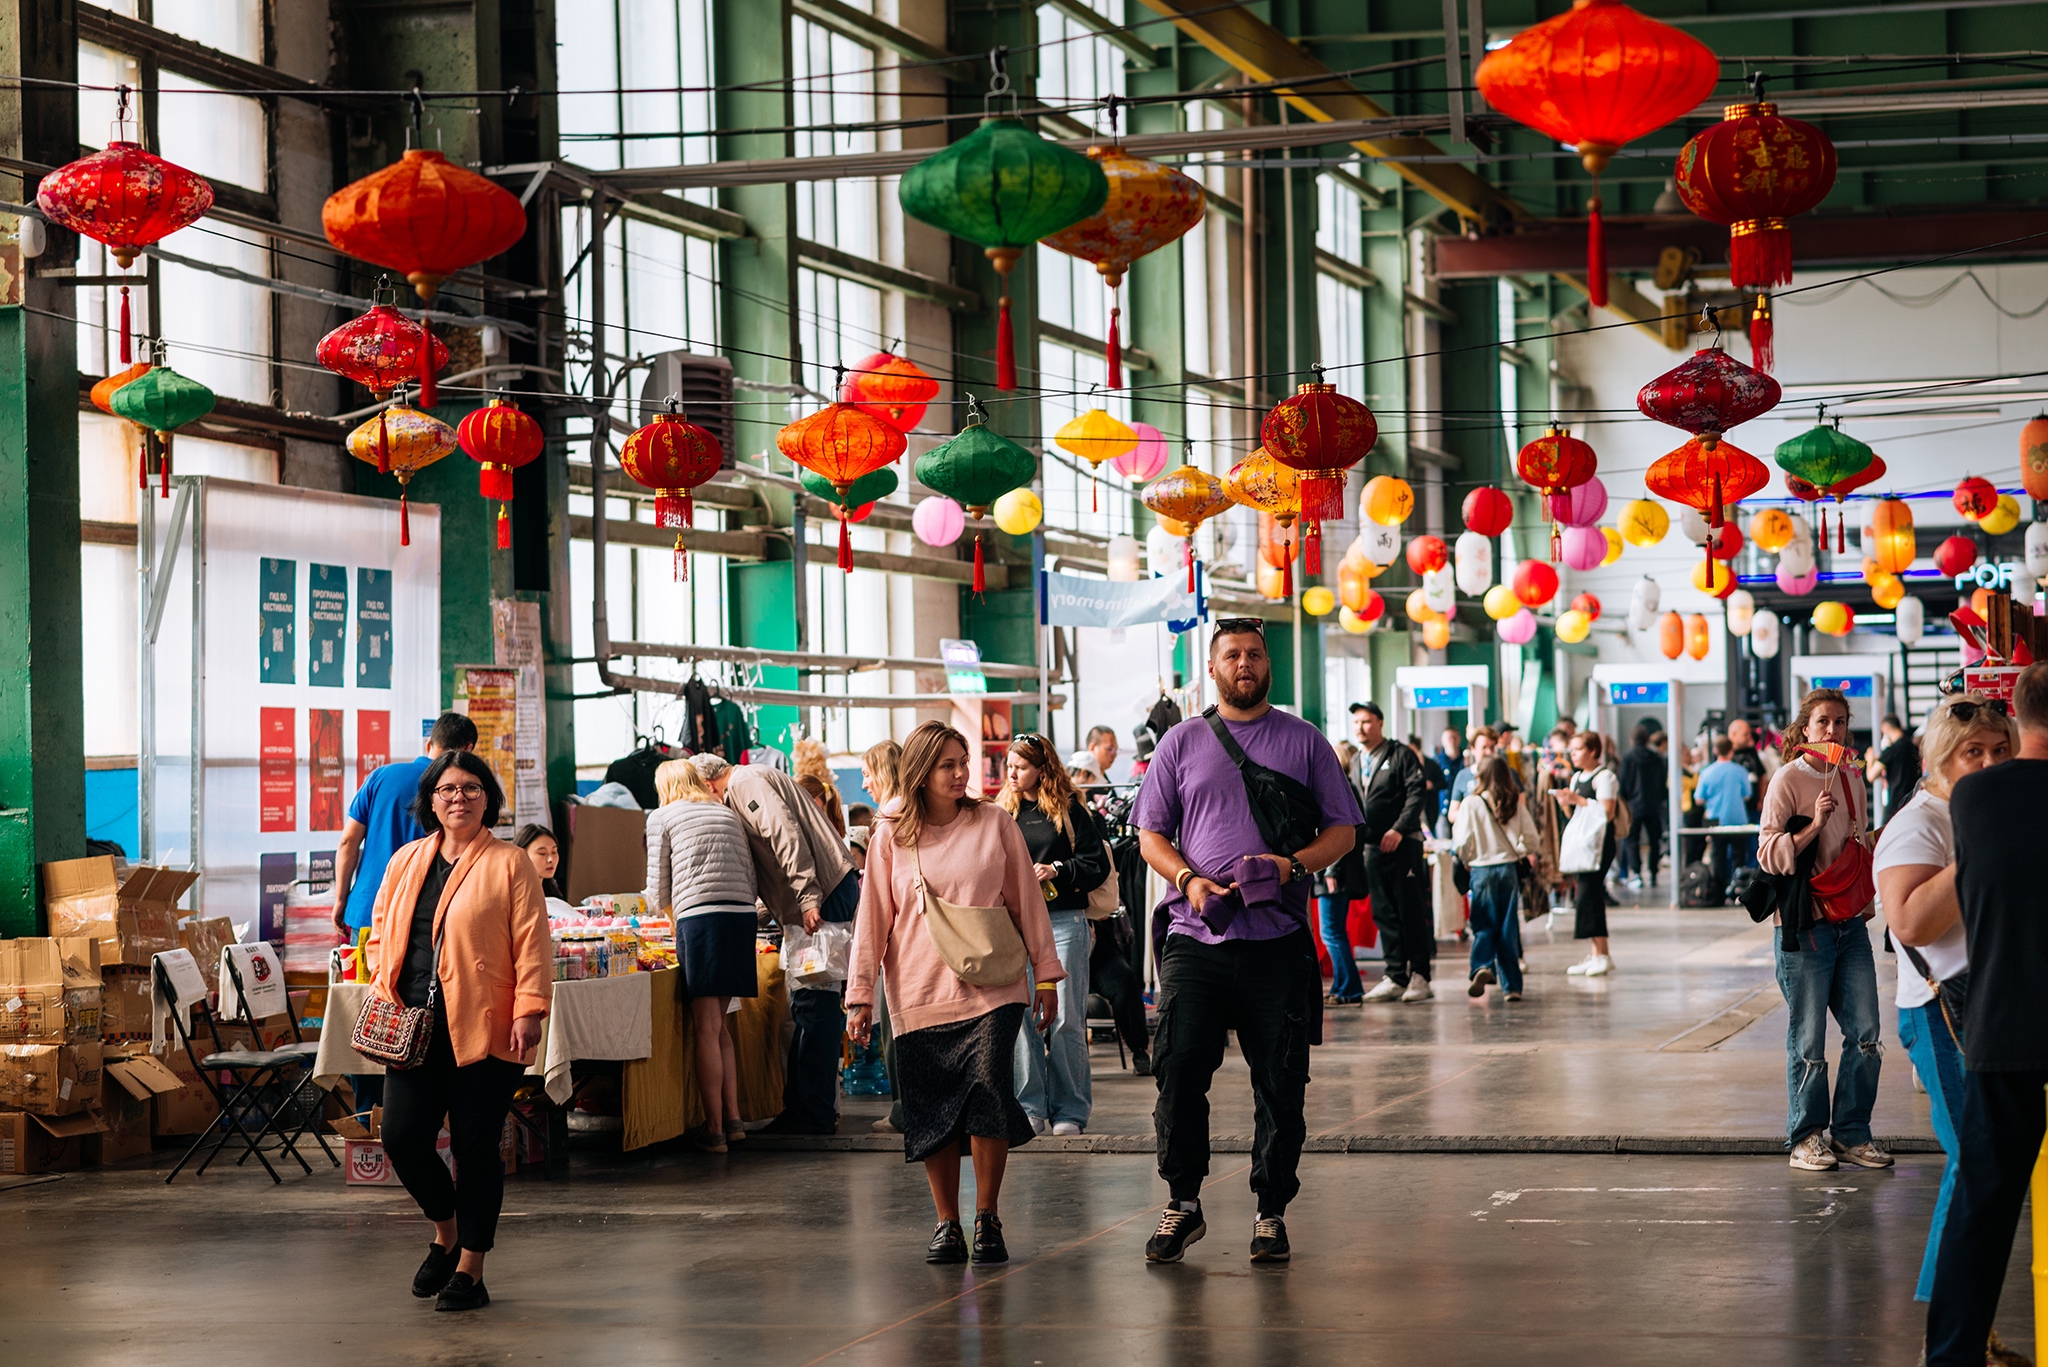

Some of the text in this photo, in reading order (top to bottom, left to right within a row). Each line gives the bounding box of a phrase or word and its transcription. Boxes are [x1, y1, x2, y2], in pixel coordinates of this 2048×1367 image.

[312, 589, 345, 600] ПРОГРАММА
[262, 602, 293, 613] ФЕСТИВАЛЮ
[320, 602, 342, 611] ДЕТАЛИ
[313, 611, 344, 621] ФЕСТИВАЛЯ
[360, 610, 390, 621] ФЕСТИВАЛЮ
[312, 859, 332, 869] УЗНАТЬ
[312, 870, 334, 879] БОЛЬШЕ
